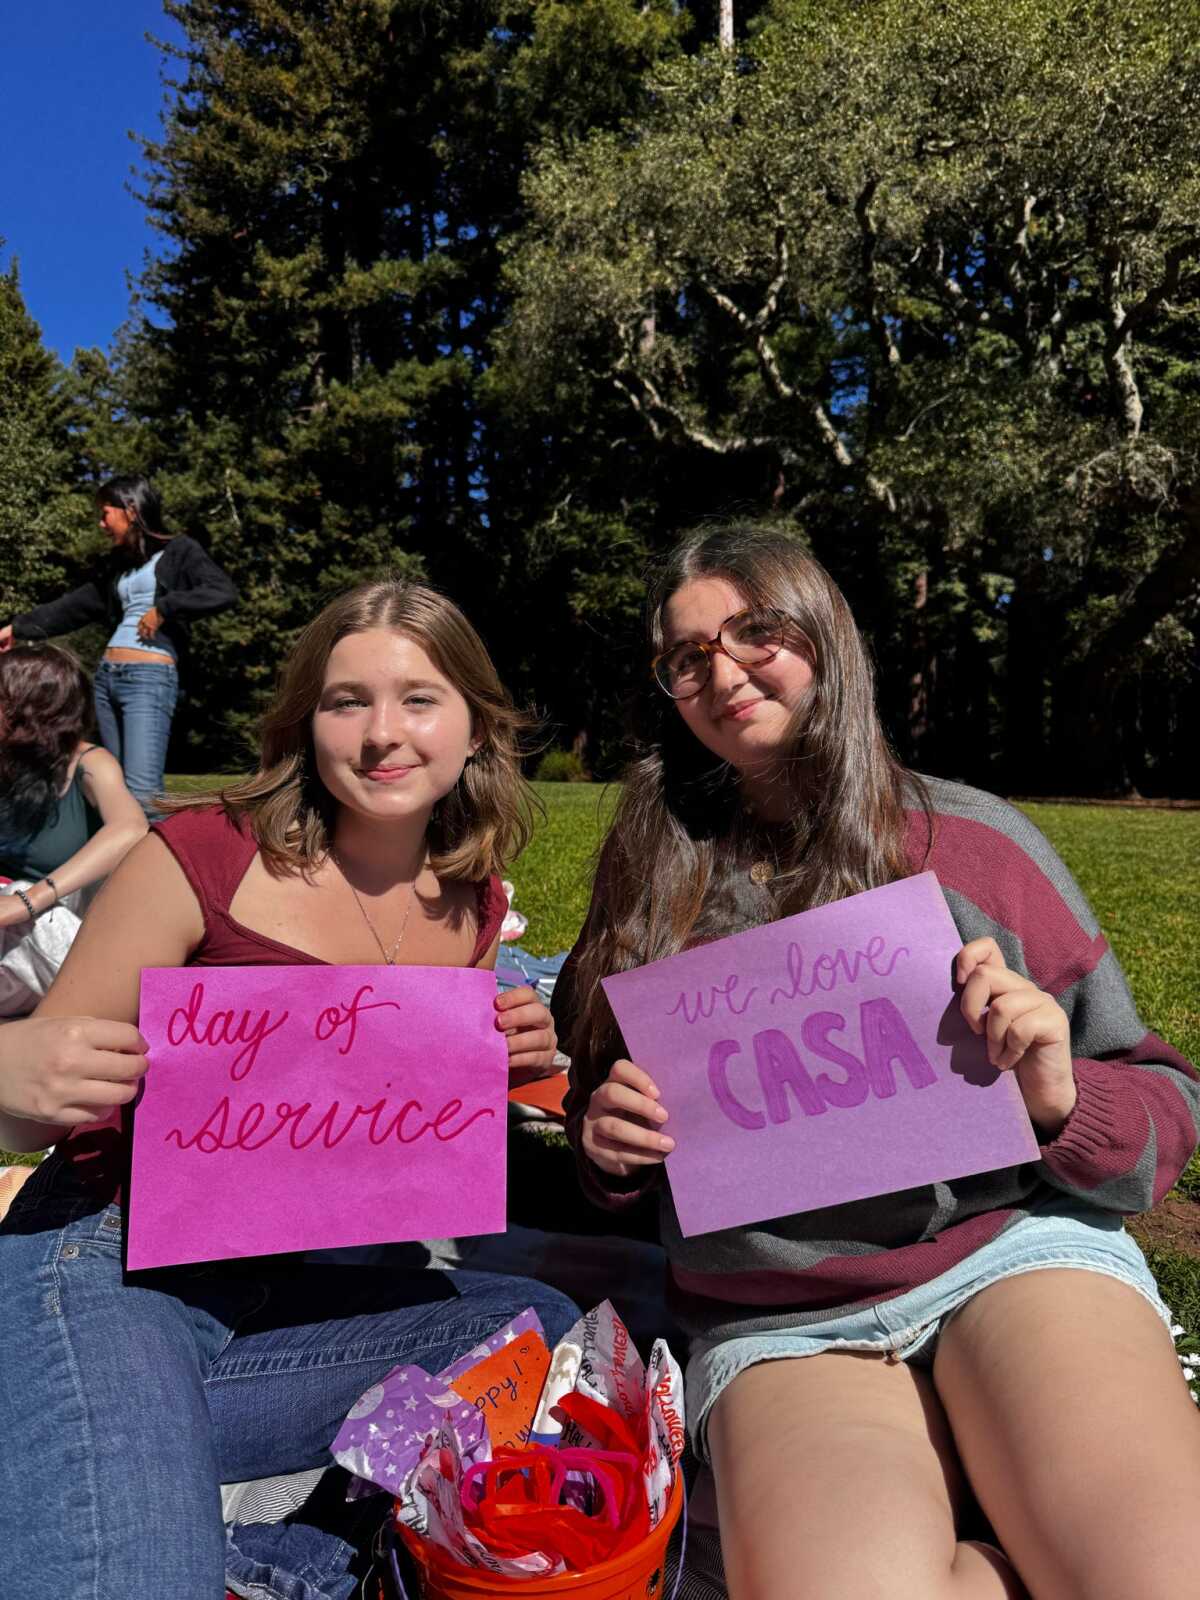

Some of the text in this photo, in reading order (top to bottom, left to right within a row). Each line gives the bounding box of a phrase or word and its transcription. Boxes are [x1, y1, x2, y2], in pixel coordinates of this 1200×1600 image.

[665, 936, 910, 1025] we love
[167, 982, 400, 1081] day of
[707, 997, 938, 1131] CASA
[164, 1082, 495, 1153] service
